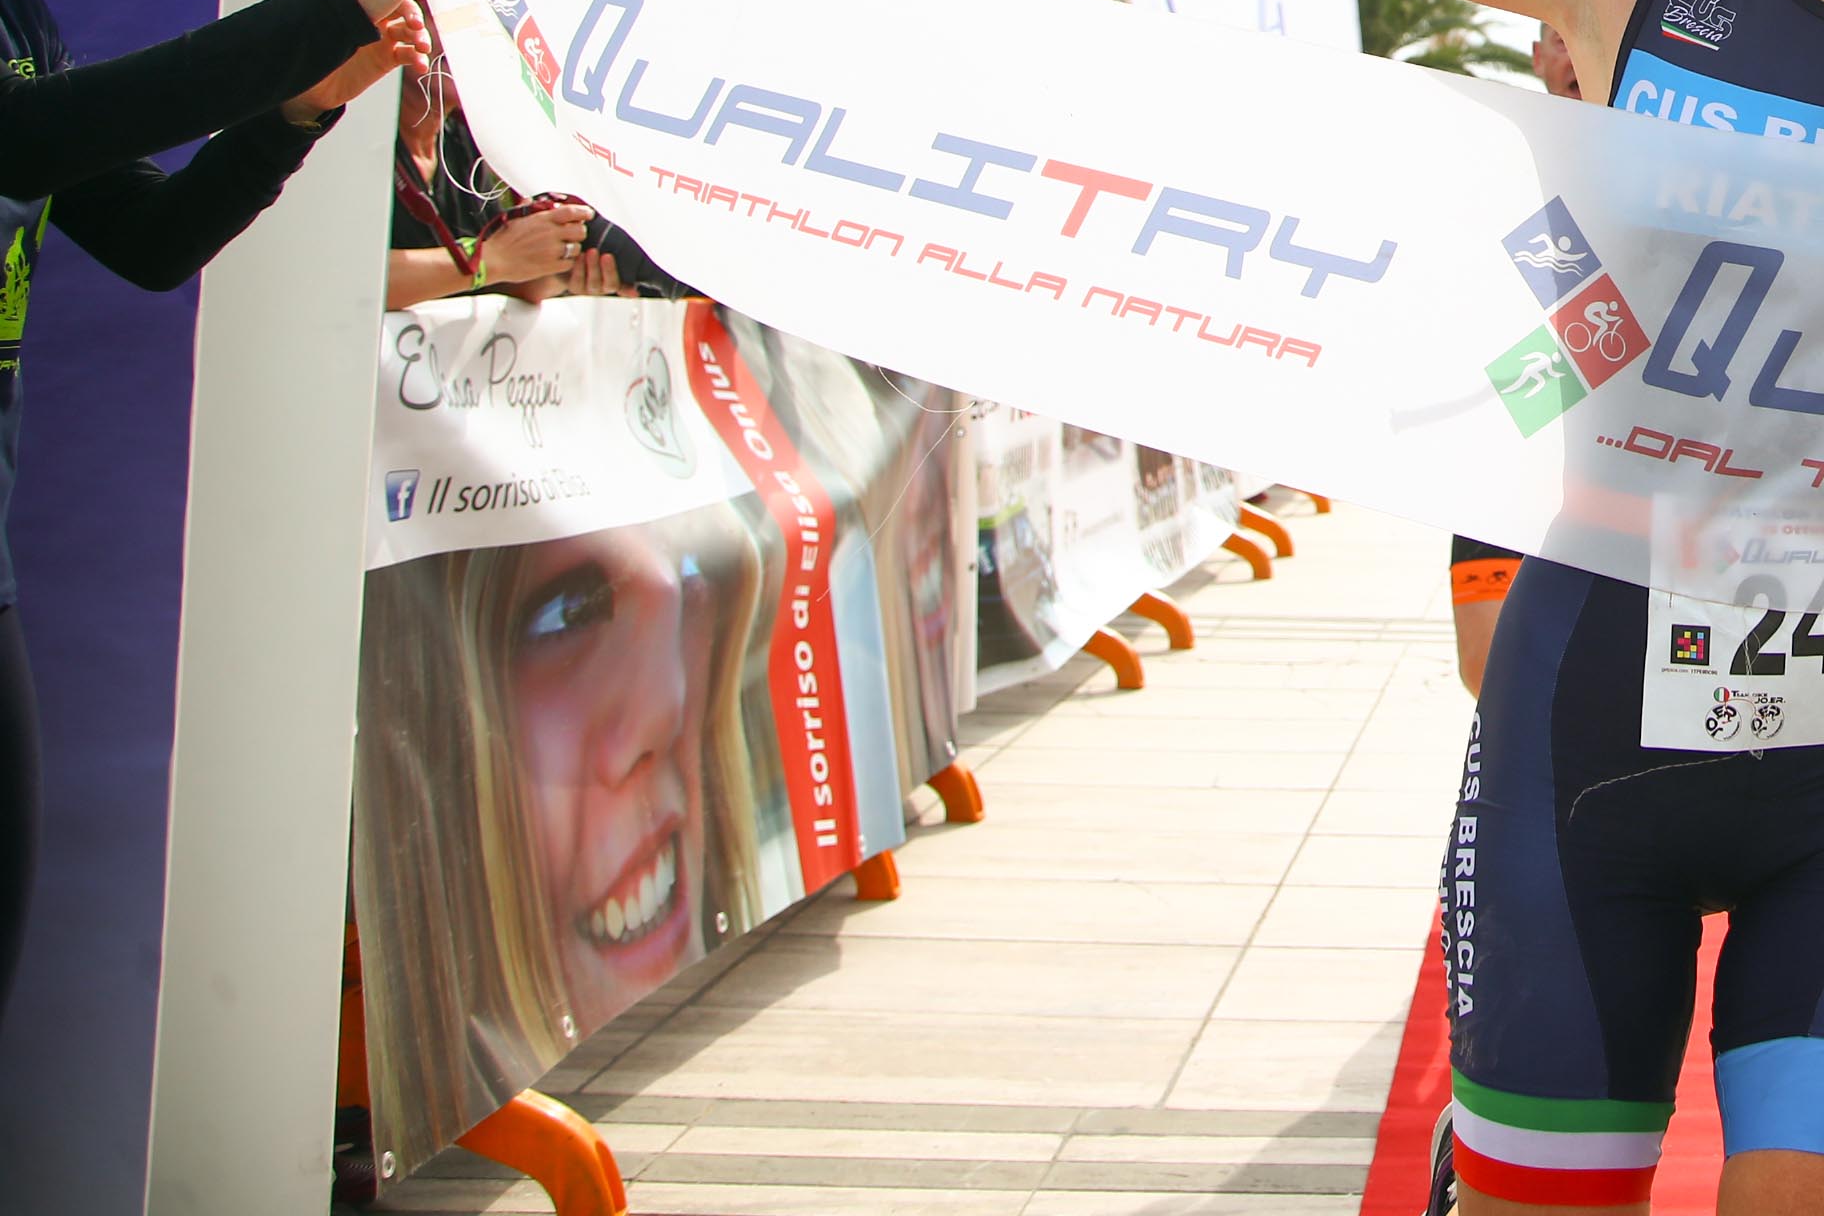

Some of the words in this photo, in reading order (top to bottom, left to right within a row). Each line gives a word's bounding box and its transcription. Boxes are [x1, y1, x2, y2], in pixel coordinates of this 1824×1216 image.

[649, 166, 904, 258] TRIATHLON
[917, 242, 1068, 301] ALLA
[1081, 286, 1323, 368] NATURA
[396, 323, 480, 411] Elisa
[454, 472, 541, 513] sorriso
[775, 469, 821, 572] Elisa
[792, 583, 810, 630] di
[794, 641, 834, 808] sorriso
[1454, 815, 1478, 1018] BRESCIA
